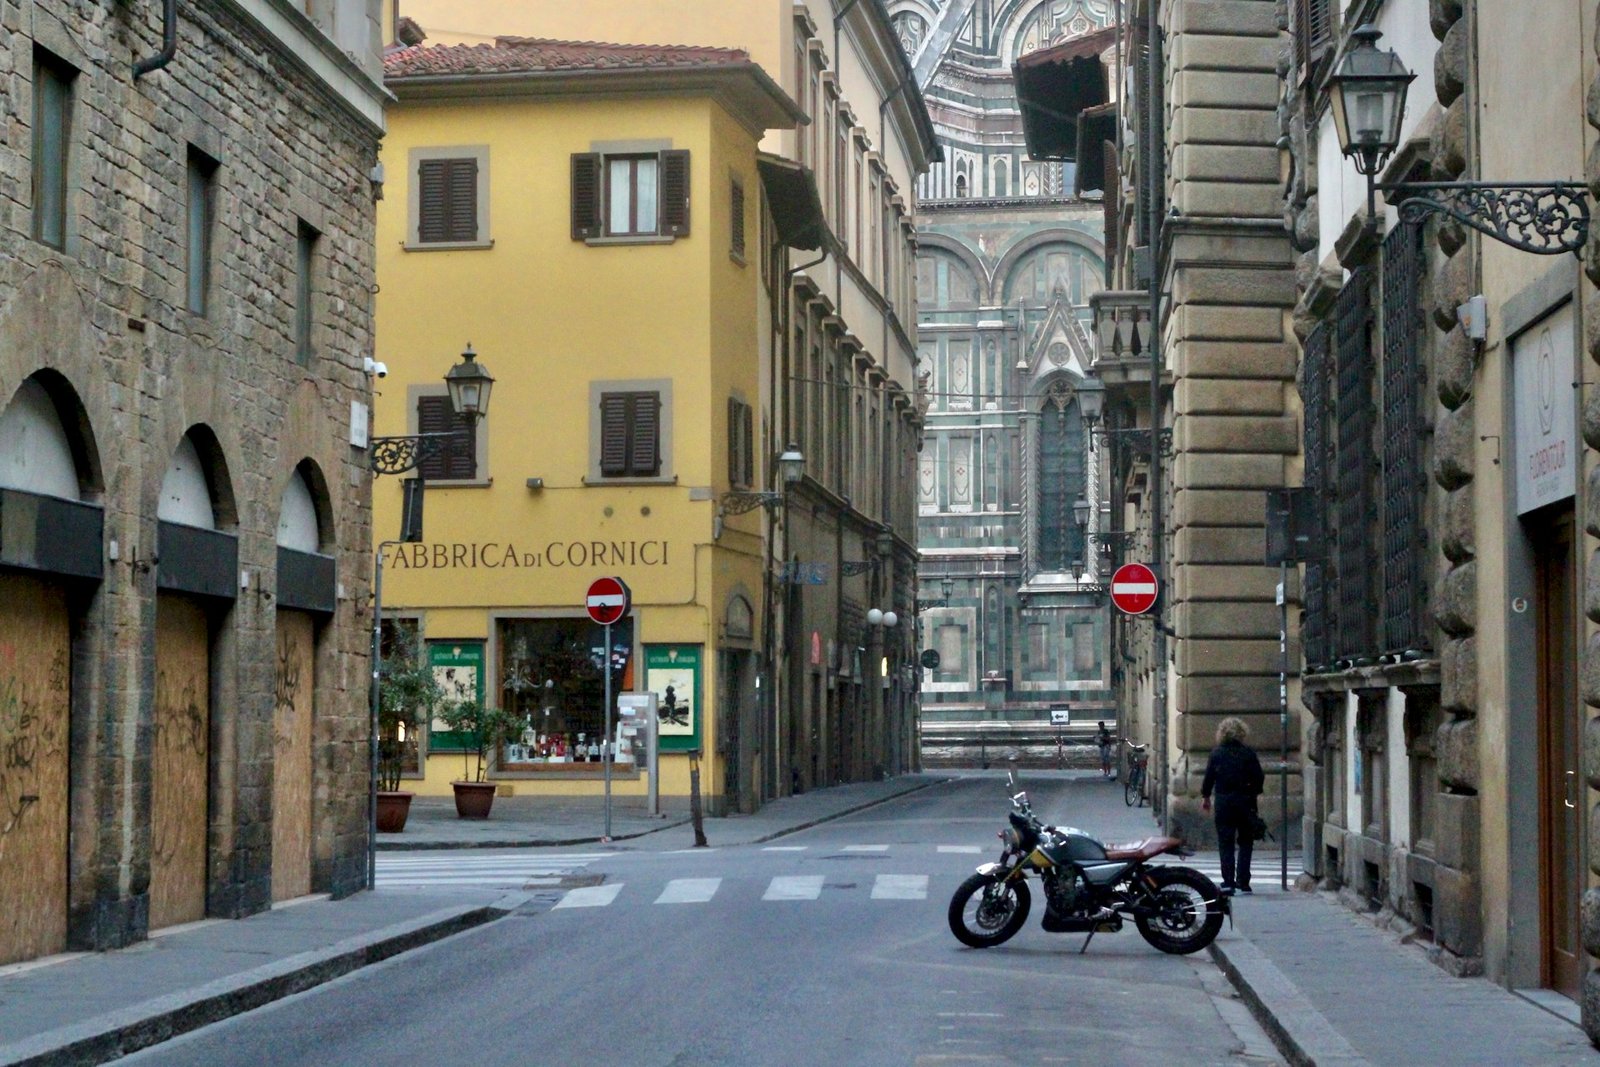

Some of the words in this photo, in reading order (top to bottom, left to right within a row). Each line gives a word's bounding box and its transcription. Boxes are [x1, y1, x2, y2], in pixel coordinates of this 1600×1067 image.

[381, 543, 520, 568] FABBRICA
[523, 553, 542, 567] DI
[546, 541, 669, 567] CORNICI
